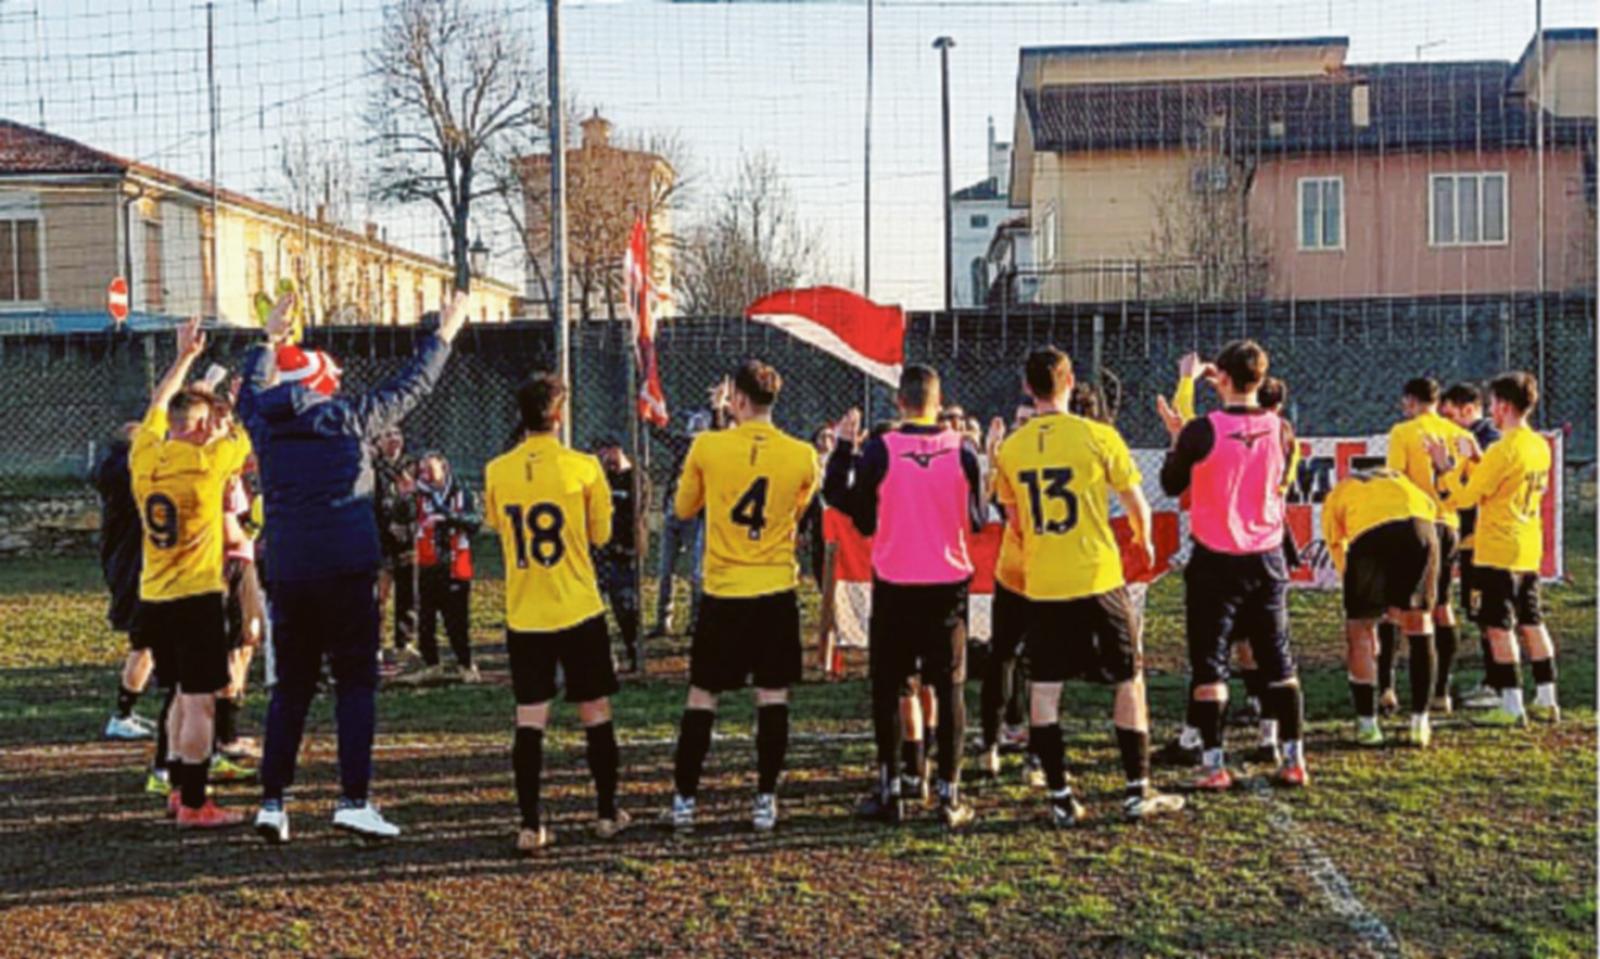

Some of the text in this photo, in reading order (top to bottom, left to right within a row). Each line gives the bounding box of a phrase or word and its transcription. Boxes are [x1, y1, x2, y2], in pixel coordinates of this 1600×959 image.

[145, 491, 178, 549] 9
[731, 475, 769, 541] 4
[1018, 467, 1078, 536] 13
[504, 502, 565, 568] 18
